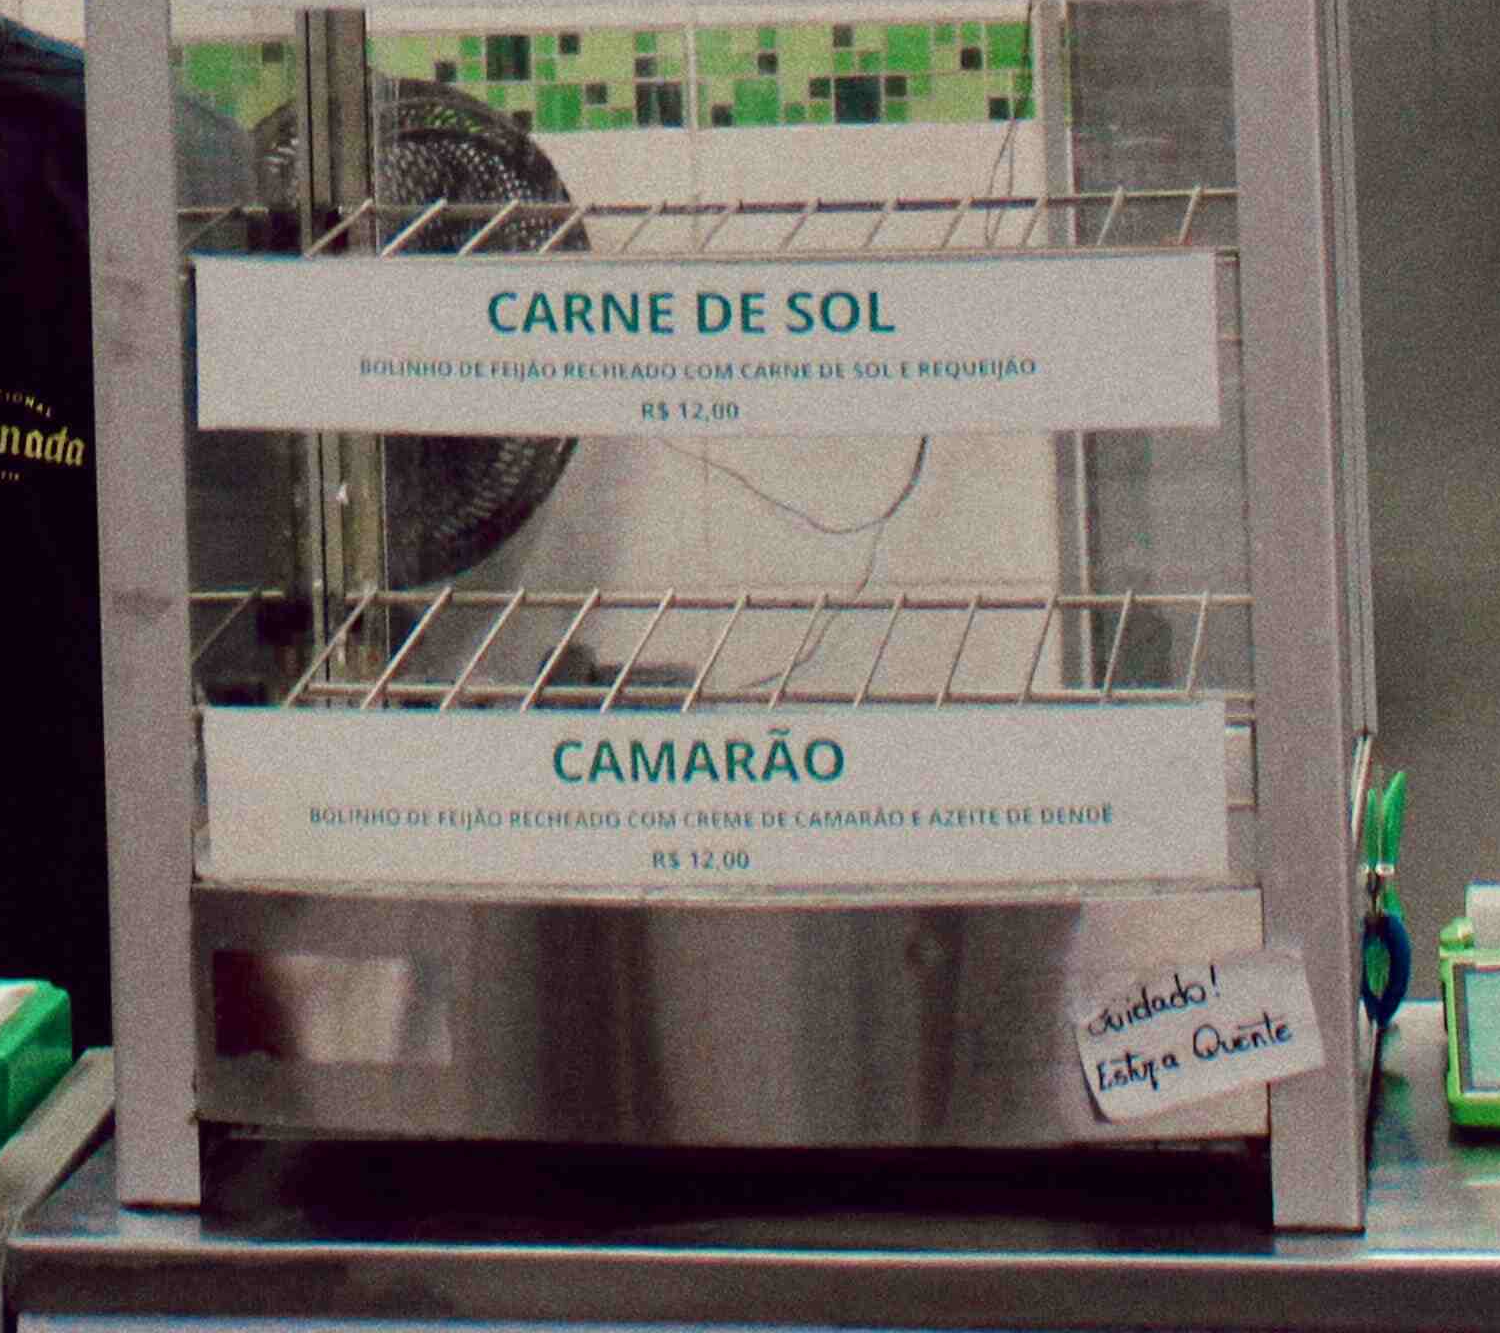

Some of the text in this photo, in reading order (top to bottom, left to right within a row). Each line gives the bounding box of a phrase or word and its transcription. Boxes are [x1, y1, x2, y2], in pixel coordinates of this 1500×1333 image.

[487, 290, 896, 335] CARNE DE SOL
[359, 359, 454, 378] BOLINHO
[458, 361, 485, 379] DE
[562, 361, 678, 382] RECHEADO
[683, 362, 735, 381] COM
[739, 362, 812, 382] CARNE
[817, 362, 845, 380] DE
[852, 361, 893, 380] SOL
[640, 401, 740, 422] R$ 12,00
[552, 728, 845, 783] CAMARÃO
[309, 807, 402, 828] BOLINHO
[405, 810, 430, 827] DE
[509, 810, 622, 831] RECHEADO
[627, 811, 677, 831] COM
[683, 810, 755, 831] CREME
[760, 811, 788, 829] DE
[927, 807, 1001, 829] AZEITE
[1005, 806, 1033, 827] DE
[651, 850, 751, 871] R$ 12,00
